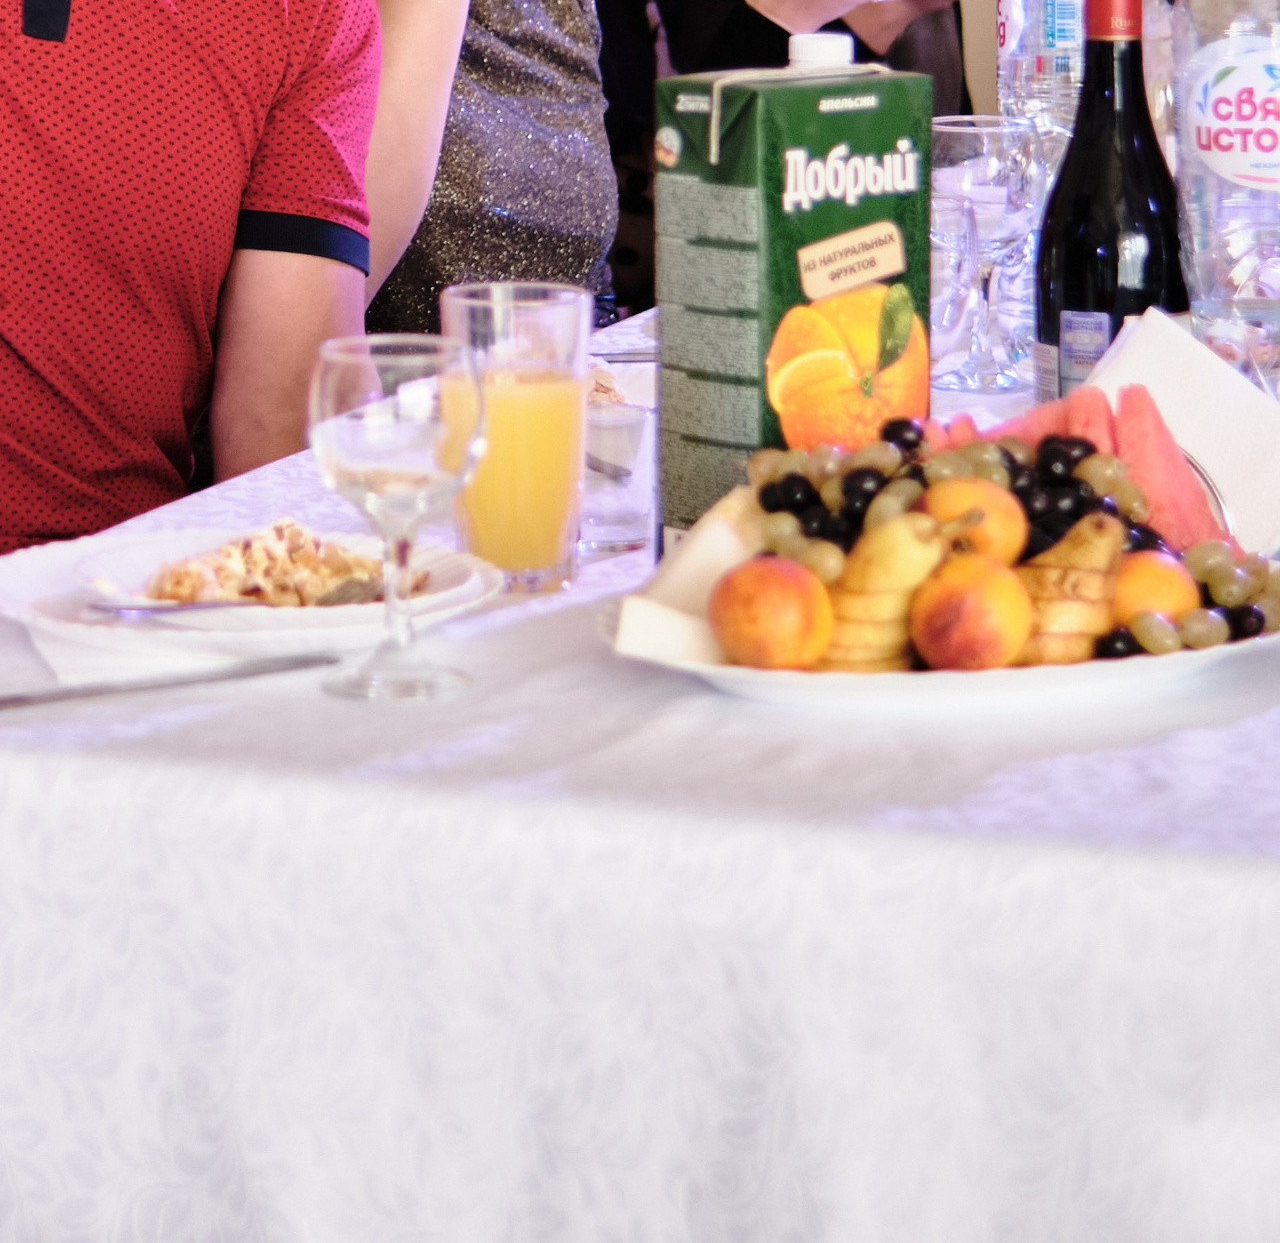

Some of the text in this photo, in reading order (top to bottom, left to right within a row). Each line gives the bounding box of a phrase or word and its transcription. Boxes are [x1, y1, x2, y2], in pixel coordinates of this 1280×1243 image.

[818, 94, 879, 112] апельсин
[782, 137, 919, 212] Добрый
[802, 231, 896, 274] ИЗ НАТУРАЛЬНЫХ
[828, 257, 877, 282] ФРУКТОВ
